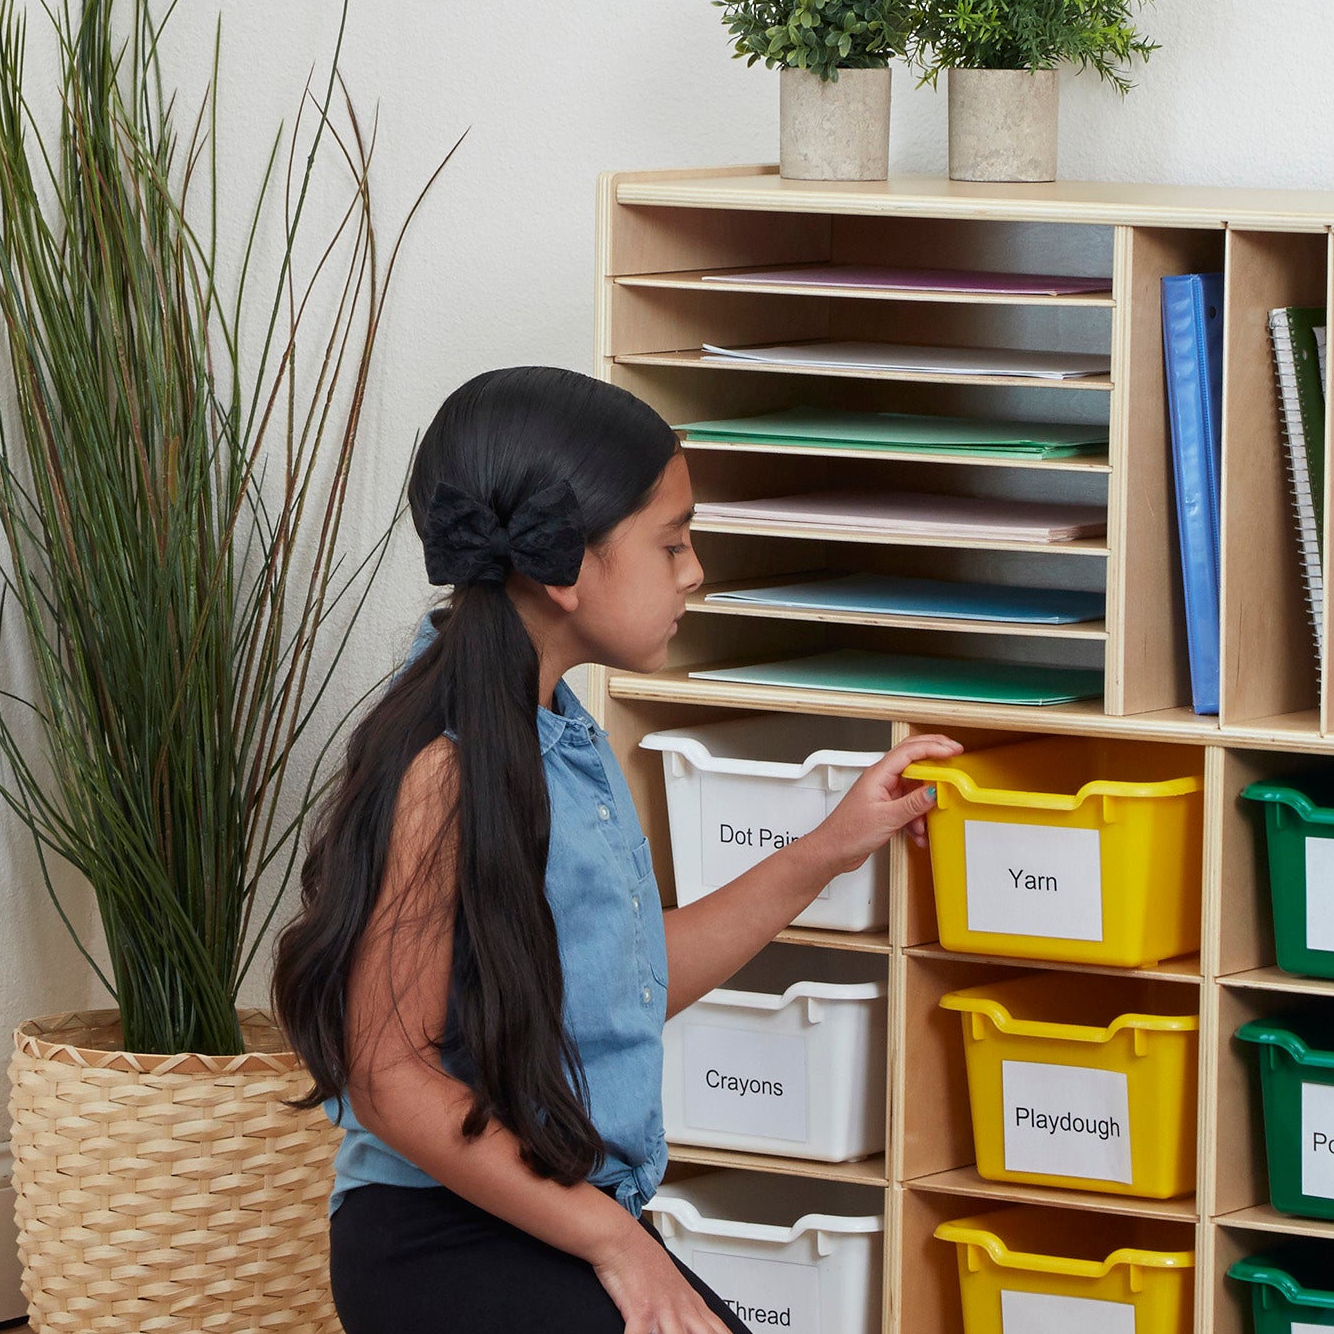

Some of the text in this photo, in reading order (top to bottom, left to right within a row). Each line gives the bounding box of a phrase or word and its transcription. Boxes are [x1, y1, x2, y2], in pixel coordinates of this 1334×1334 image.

[720, 823, 805, 849] Dot Pai
[1008, 868, 1058, 892] Yarn
[705, 1069, 784, 1097] Crayons
[1015, 1106, 1121, 1140] Playdough
